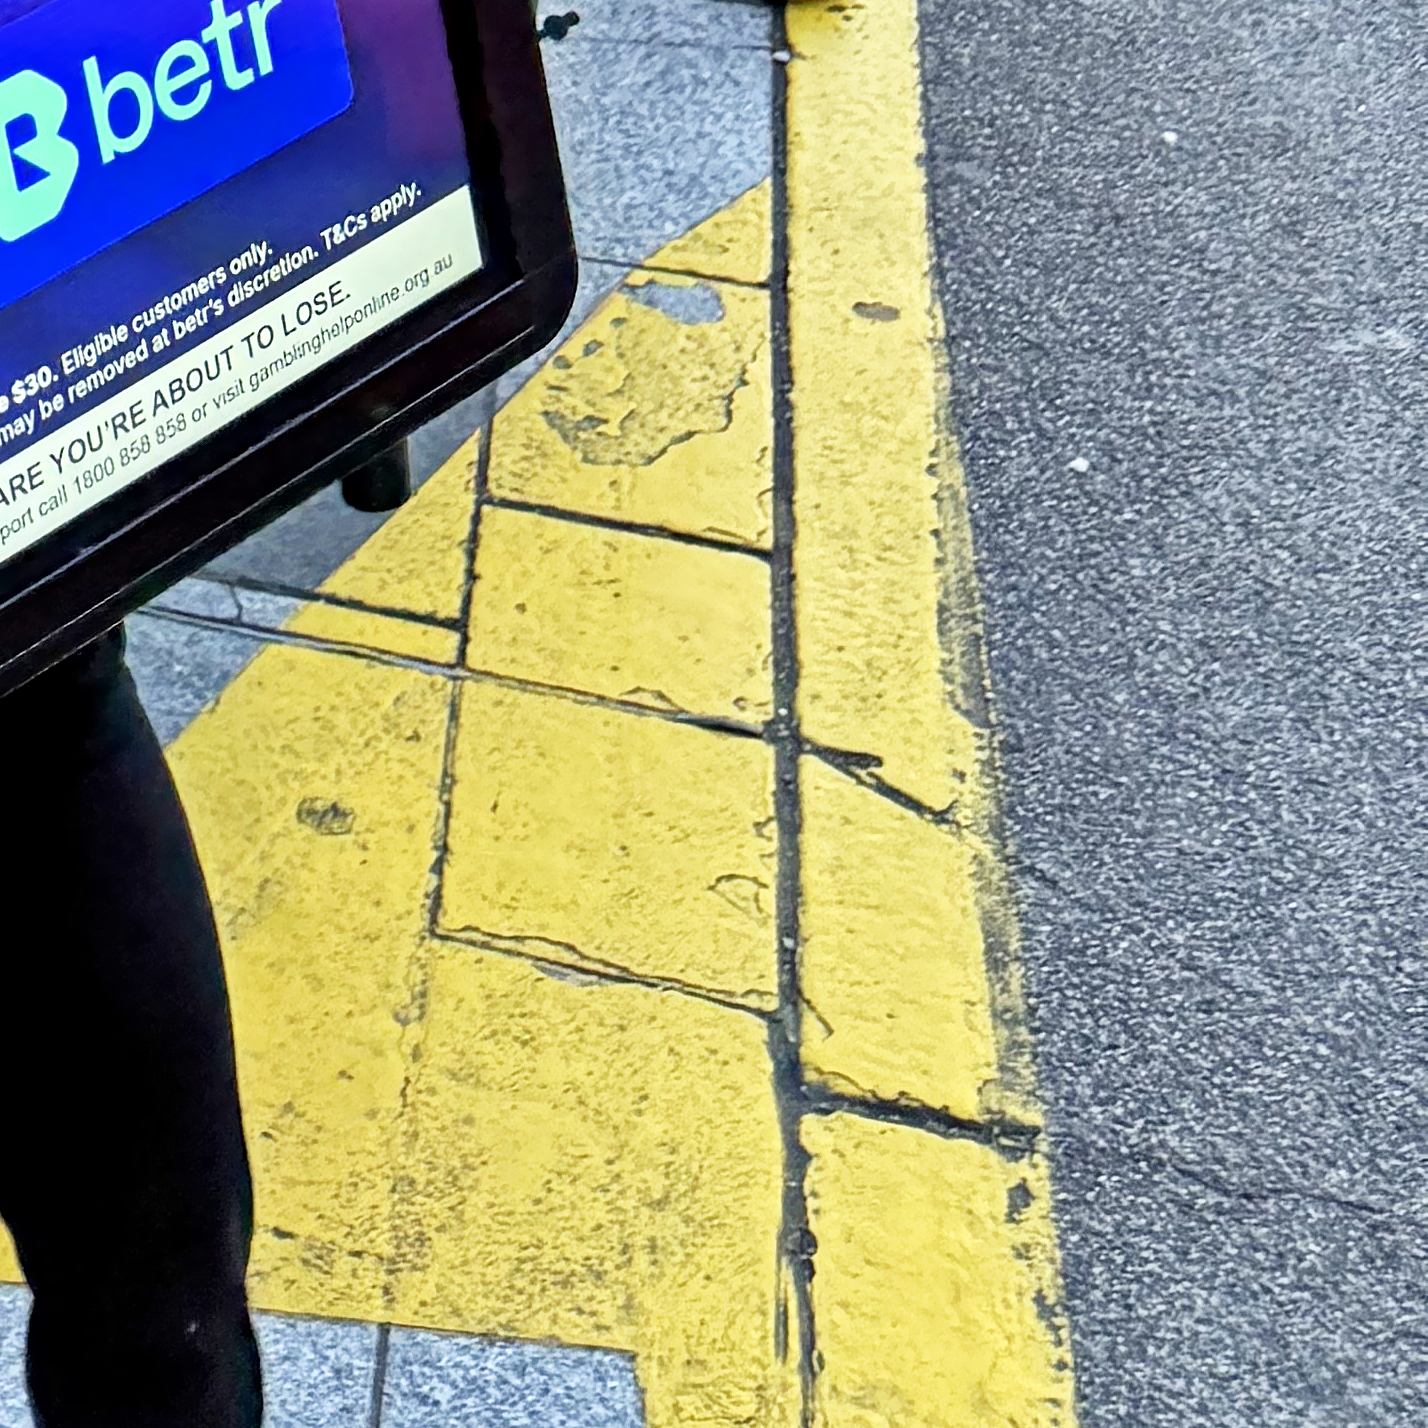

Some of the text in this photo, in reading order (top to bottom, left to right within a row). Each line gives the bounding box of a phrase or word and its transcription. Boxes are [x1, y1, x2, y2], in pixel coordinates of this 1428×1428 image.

[9, 363, 61, 406] $30.
[59, 322, 131, 377] Eligible
[129, 264, 229, 335] customers
[227, 238, 275, 277] only.
[36, 391, 67, 423] be
[65, 335, 151, 406] removed
[149, 325, 173, 355] at
[170, 296, 227, 342] betr's
[225, 243, 321, 309] discretion.
[317, 211, 370, 253] T&Cs
[368, 180, 424, 225] apply.
[47, 398, 149, 476] YOU'RE
[150, 342, 236, 420] ABOUT
[238, 322, 276, 360] TO
[279, 278, 353, 339] LOSE.
[36, 482, 70, 518] call
[73, 455, 117, 496] 1800
[117, 432, 153, 469] 858
[153, 411, 189, 447] 858
[189, 400, 209, 424] or
[210, 376, 247, 411] visit
